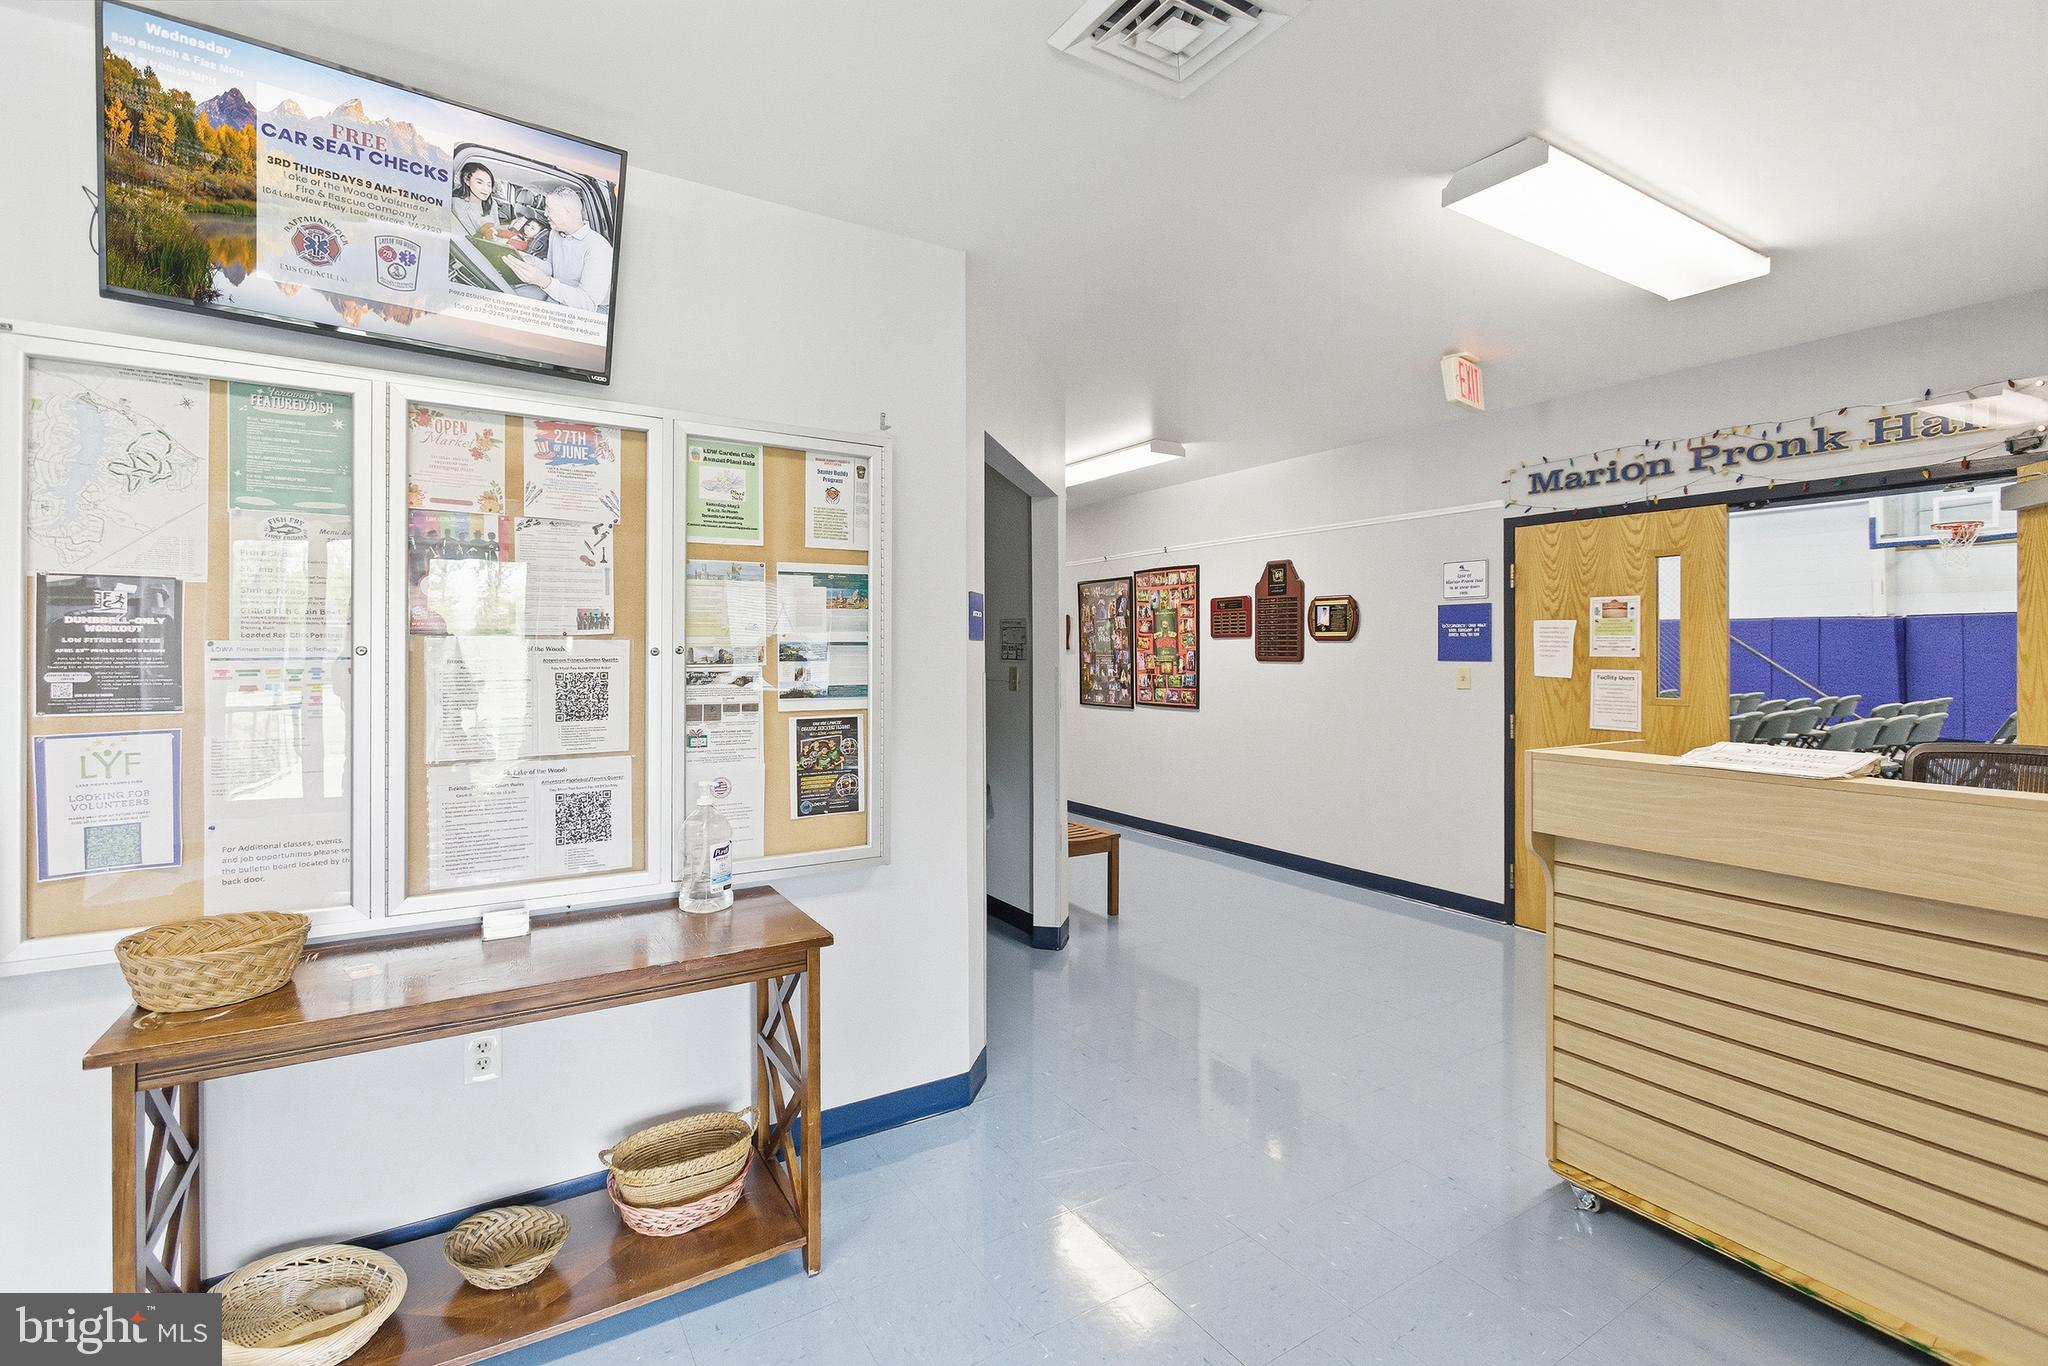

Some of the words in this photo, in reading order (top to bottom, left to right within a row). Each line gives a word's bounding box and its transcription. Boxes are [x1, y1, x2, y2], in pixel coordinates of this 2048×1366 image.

[145, 22, 232, 58] Wednesday
[331, 123, 387, 151] FREE
[261, 123, 307, 147] CAR
[312, 136, 364, 161] SEAT
[368, 151, 449, 183] CHECKS
[267, 155, 291, 168] 3RD
[293, 162, 363, 187] THURSDAYS
[365, 179, 373, 189] 9
[410, 192, 443, 207] NOON
[262, 185, 278, 195] 104
[310, 177, 320, 187] of
[323, 179, 341, 192] the
[343, 185, 378, 201] Woods
[380, 195, 429, 213] Volunteer
[295, 184, 315, 196] Fire
[317, 189, 326, 199] &
[328, 191, 366, 208] Rescue
[367, 202, 418, 221] Company
[279, 263, 297, 273] EMS
[1458, 360, 1480, 407] EXIT
[250, 394, 306, 412] FEATURED
[309, 400, 335, 414] DISH
[434, 418, 468, 436] OPEN
[421, 430, 477, 449] Market
[554, 429, 587, 446] 27TH
[561, 445, 589, 461] JUNE
[1526, 457, 1674, 496] Marion
[1688, 425, 1850, 472] Pronk
[267, 516, 287, 525] FISH
[319, 528, 340, 536] Menu
[64, 615, 166, 625] DUMBBELL-ONLY
[84, 624, 144, 633] WORKOUT
[80, 750, 142, 779] LYF
[68, 791, 124, 803] LOOKING
[128, 789, 150, 798] FOR
[70, 798, 150, 812] VOLUNTEERS
[238, 842, 282, 852] Additional
[283, 841, 314, 849] classes,
[240, 855, 254, 864] job
[256, 850, 312, 861] opportunities
[313, 848, 340, 857] please
[221, 867, 237, 875] the
[239, 864, 271, 874] bulletin
[272, 861, 297, 870] board
[298, 859, 329, 868] located
[330, 858, 340, 866] by
[222, 878, 242, 886] back
[243, 876, 266, 885] door.
